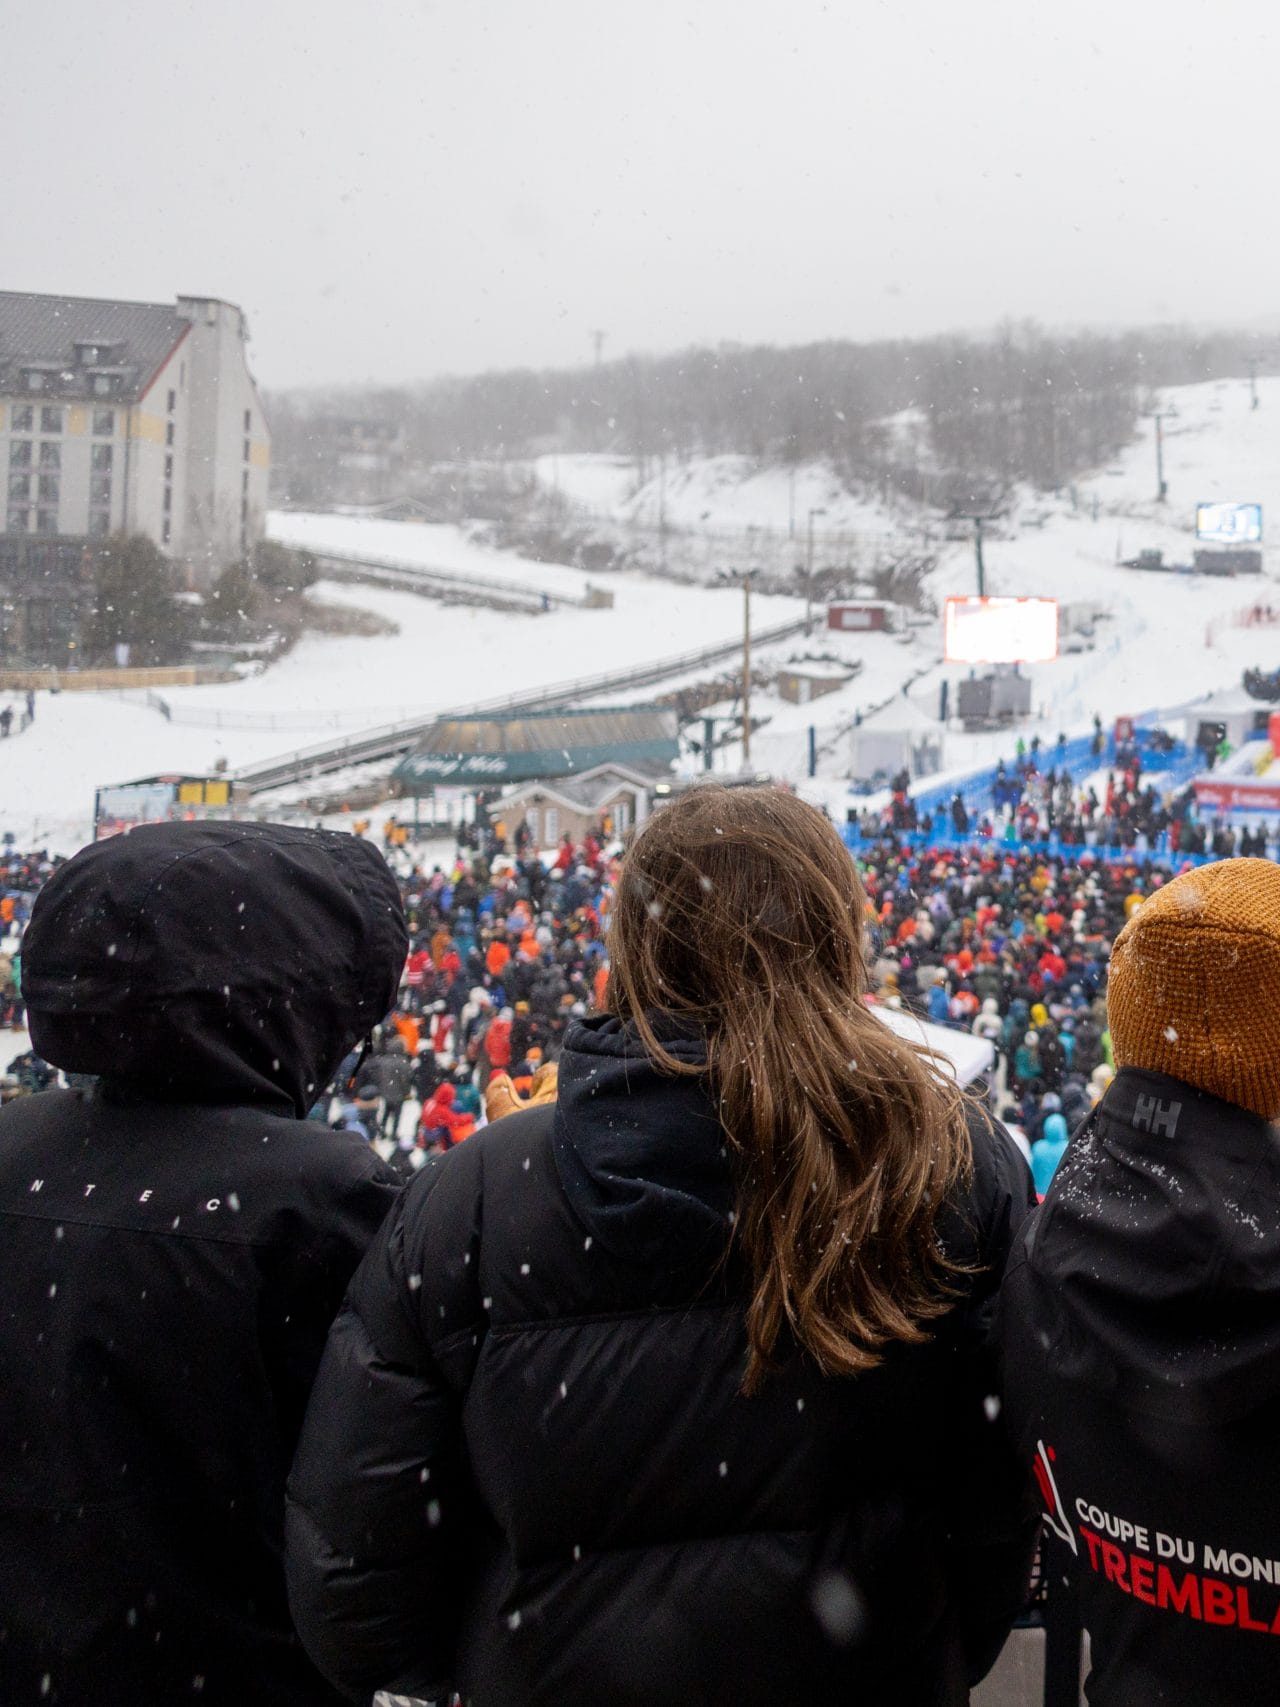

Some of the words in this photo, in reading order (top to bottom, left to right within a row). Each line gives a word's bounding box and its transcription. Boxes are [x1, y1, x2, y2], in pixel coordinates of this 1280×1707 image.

[1132, 1092, 1182, 1138] HH
[1075, 1497, 1150, 1552] COUPE
[1156, 1532, 1194, 1564] DU
